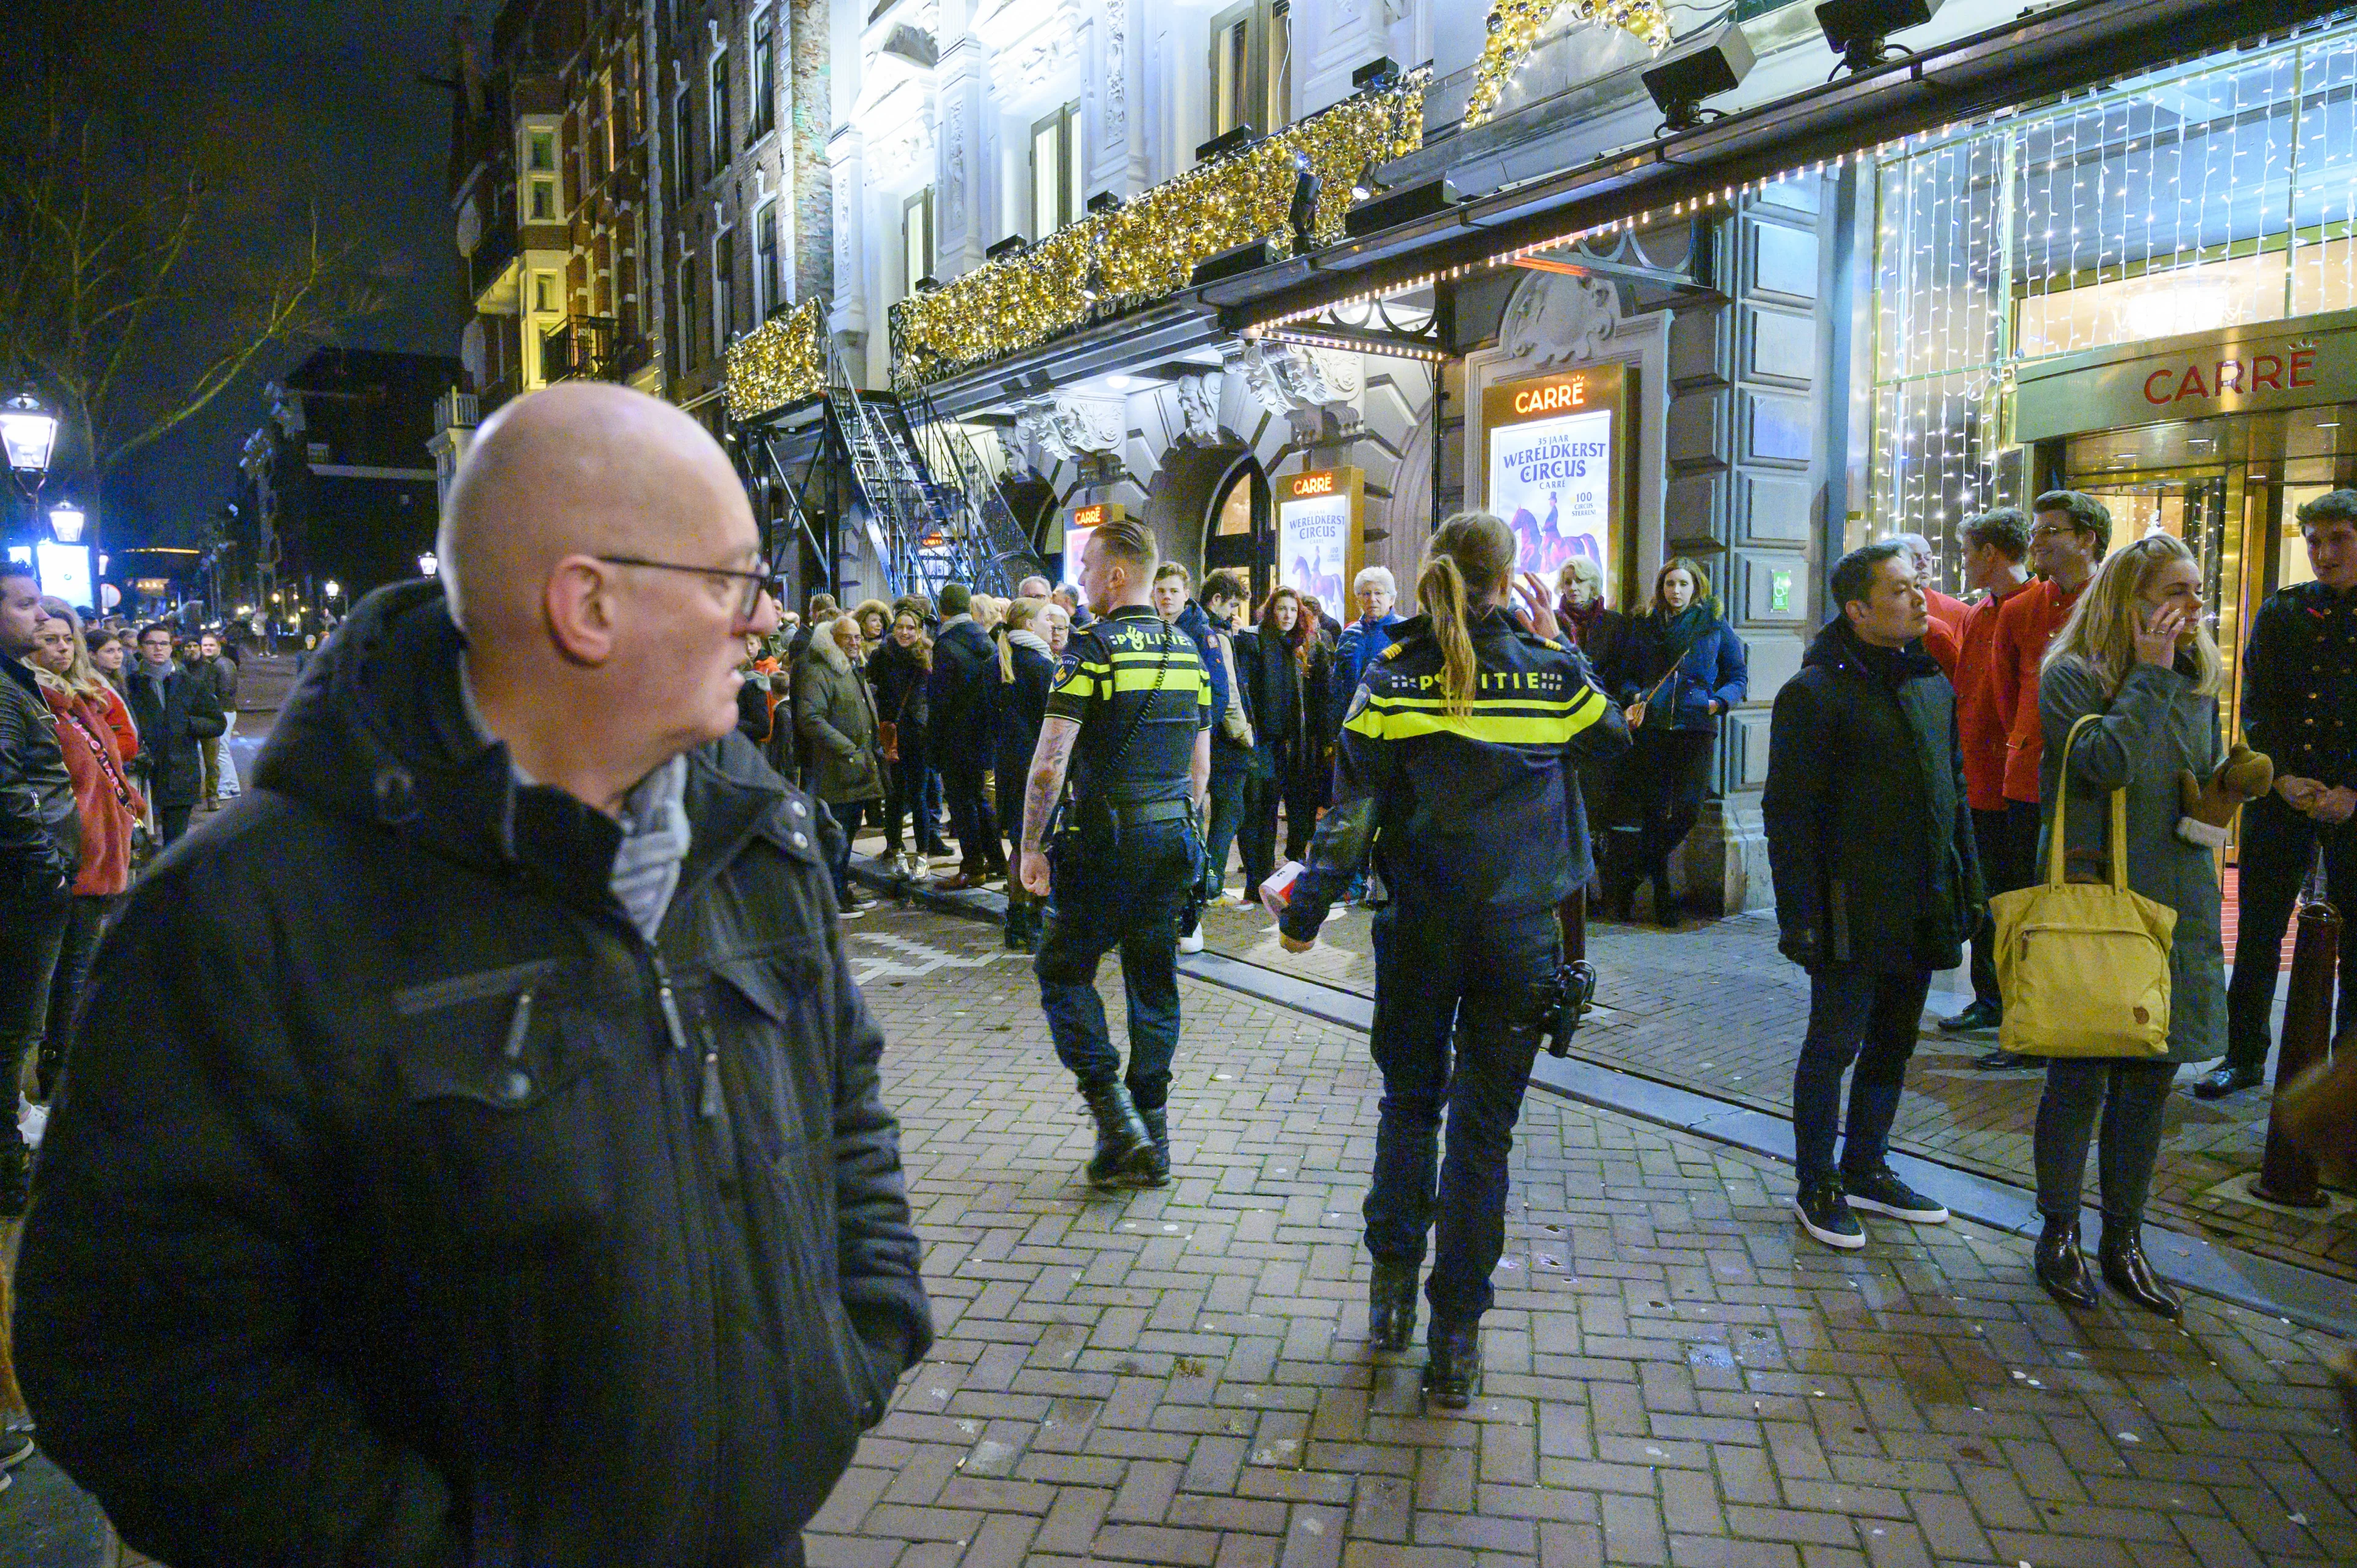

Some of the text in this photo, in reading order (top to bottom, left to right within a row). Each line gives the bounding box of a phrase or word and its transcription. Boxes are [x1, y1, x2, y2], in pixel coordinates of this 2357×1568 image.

[1538, 434, 1569, 446] 35 JAAR
[1503, 442, 1606, 469] WERELDKERST
[1520, 460, 1586, 483] CIRCUS
[1539, 478, 1565, 490] CARRÉ
[1576, 492, 1592, 503] 100
[1289, 515, 1345, 530] WERELDKERST
[1299, 526, 1336, 539] CIRCUS
